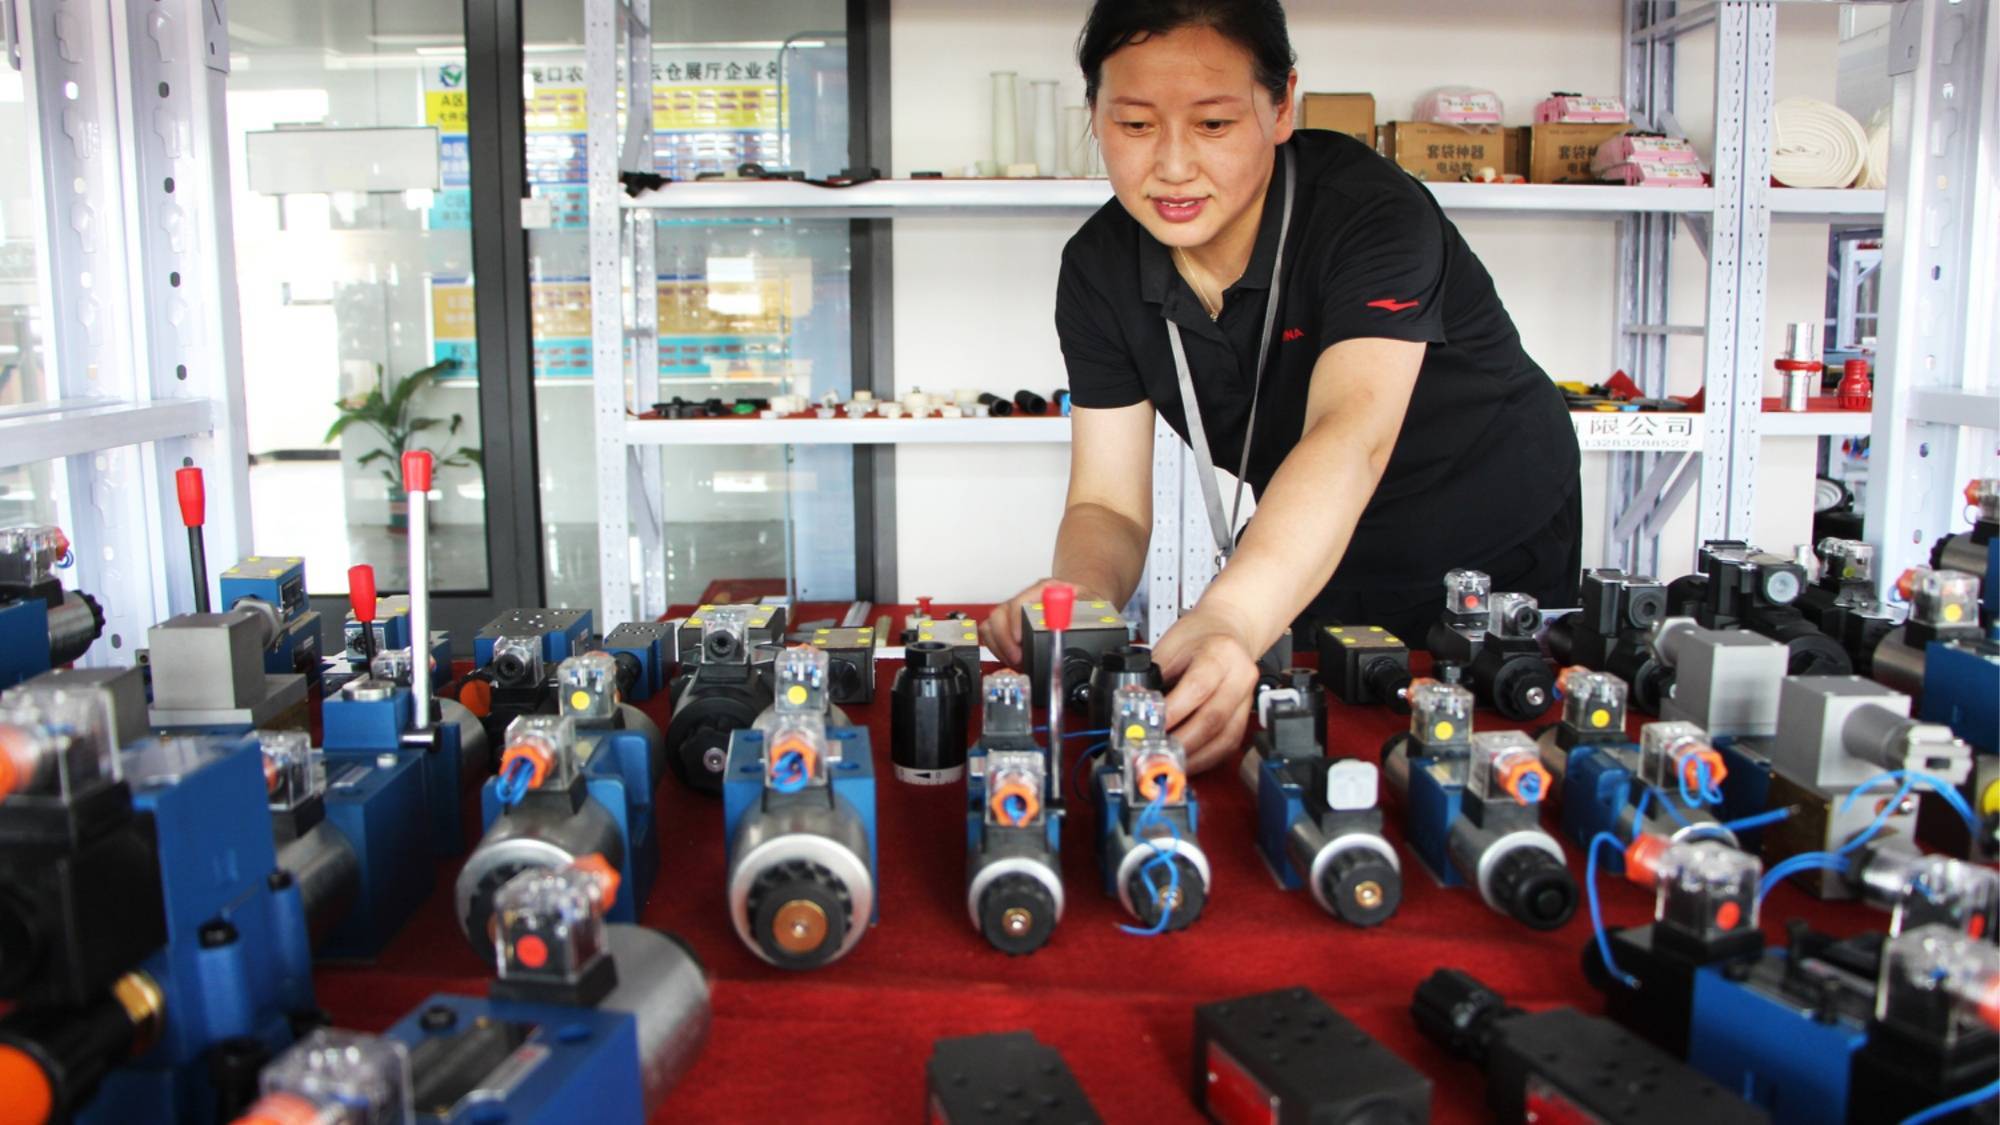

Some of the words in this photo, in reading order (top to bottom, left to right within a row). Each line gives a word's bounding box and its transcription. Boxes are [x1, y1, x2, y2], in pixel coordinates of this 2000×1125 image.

[1427, 145, 1484, 160] 套袋神器
[1575, 415, 1693, 436] 限公司
